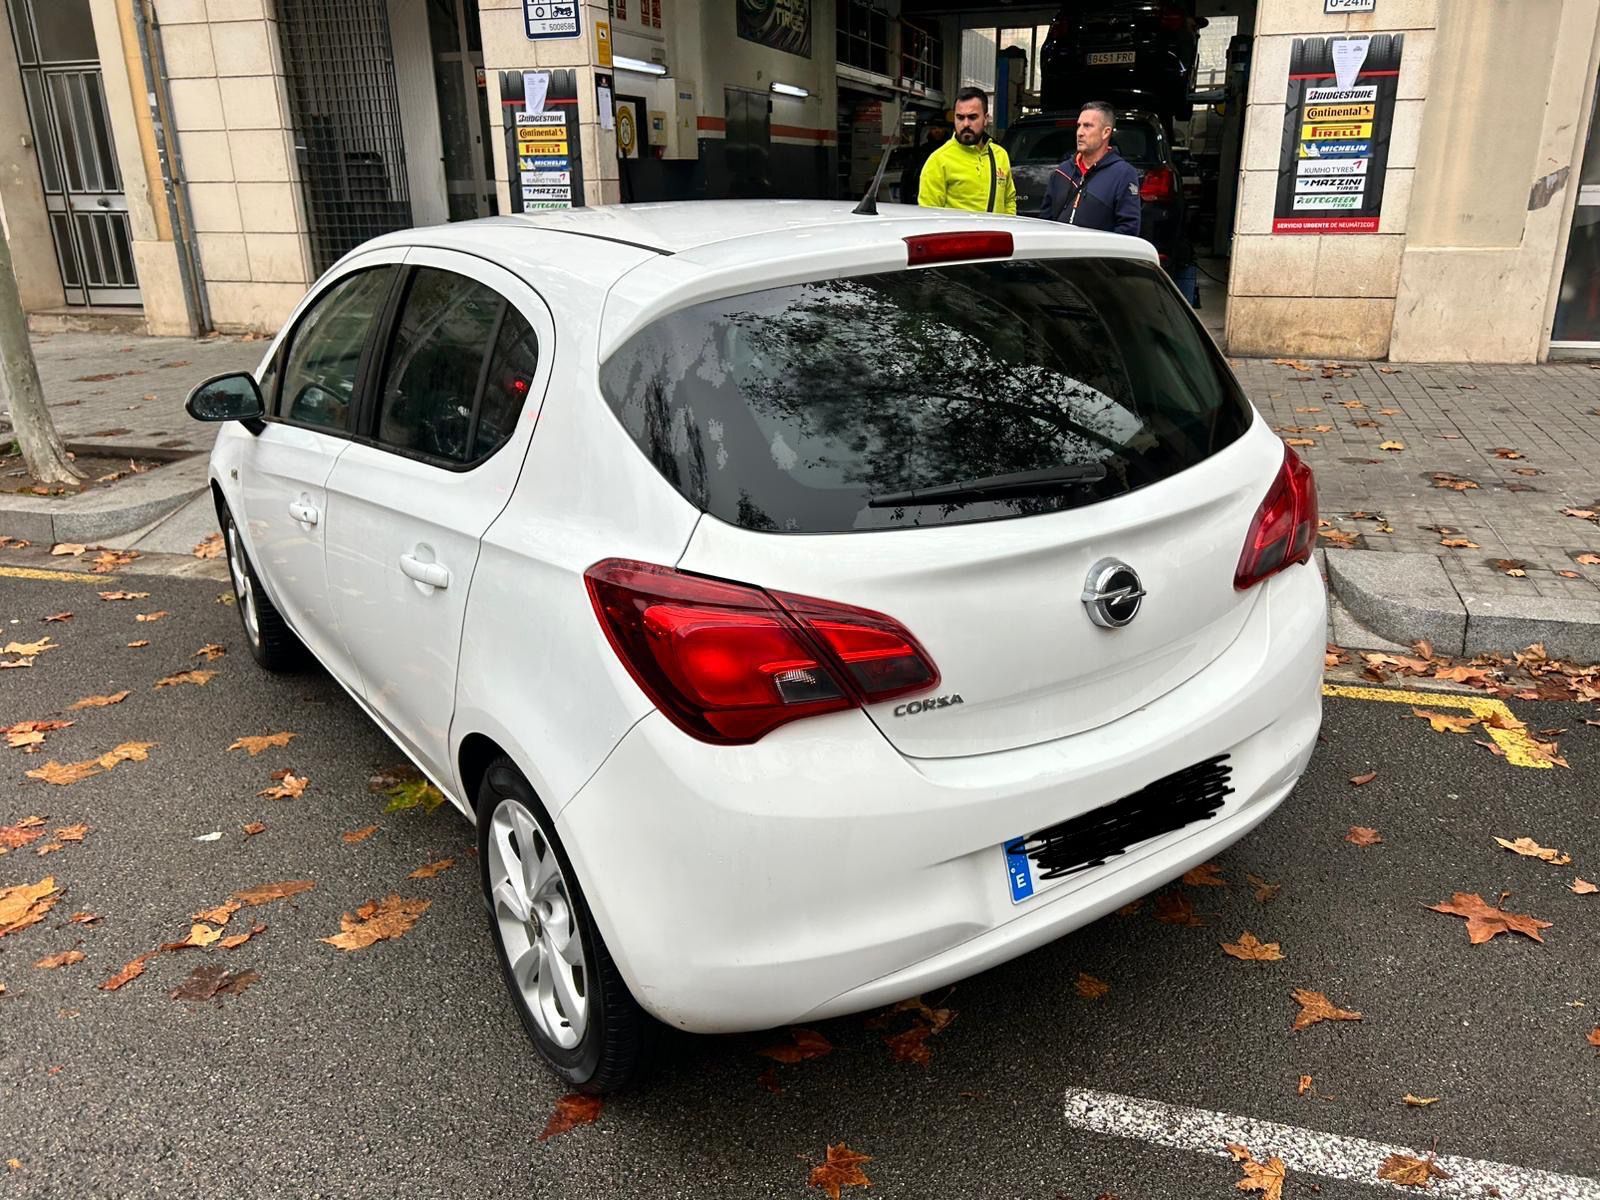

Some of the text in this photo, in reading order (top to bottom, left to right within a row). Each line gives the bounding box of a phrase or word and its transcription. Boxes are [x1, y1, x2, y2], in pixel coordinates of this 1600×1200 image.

[1308, 90, 1373, 100] BRIDGESTONE
[1307, 106, 1362, 119] Continental
[520, 129, 557, 138] Continental
[1311, 125, 1362, 138] PIRELLI
[526, 144, 560, 153] PIRELLI
[1310, 178, 1362, 186] MAZZINI
[894, 694, 964, 717] CORSA
